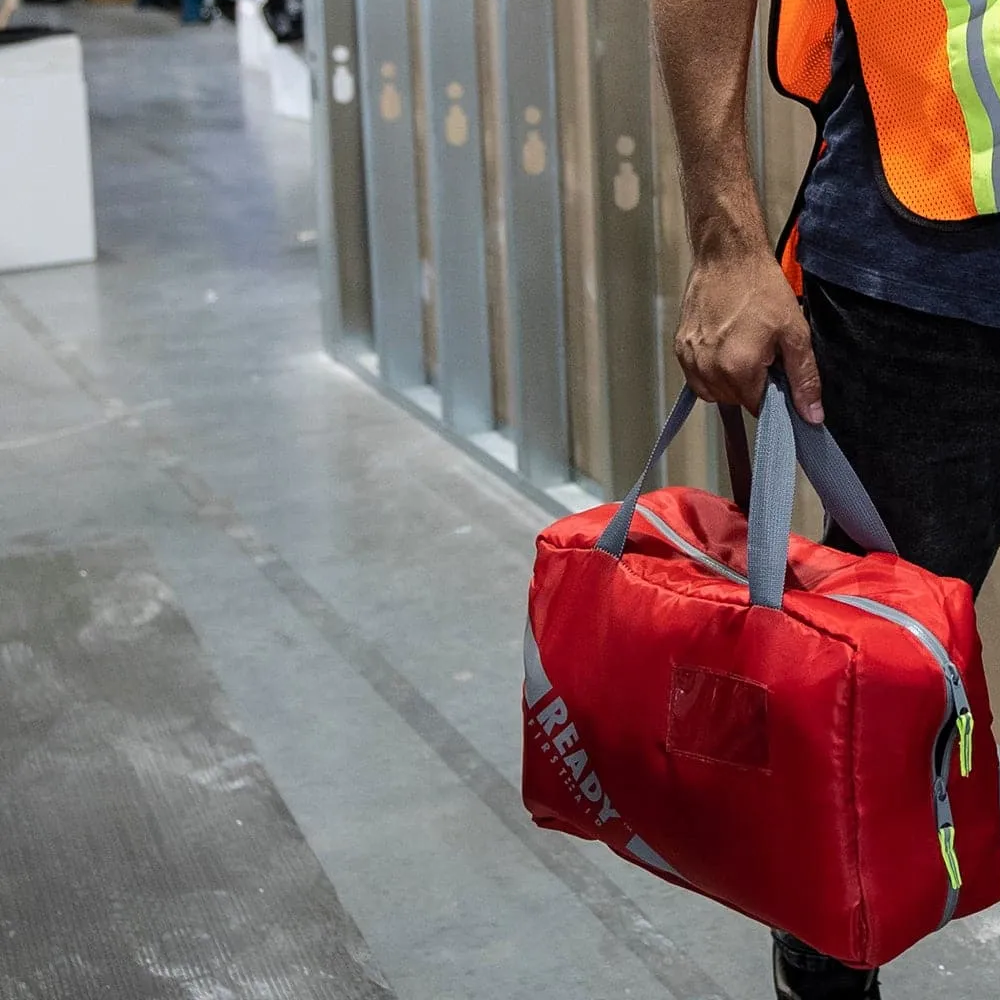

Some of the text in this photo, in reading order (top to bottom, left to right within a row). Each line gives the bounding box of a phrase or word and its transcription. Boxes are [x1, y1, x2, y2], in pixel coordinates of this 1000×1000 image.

[528, 719, 602, 827] FIRST AID
[536, 695, 621, 824] READY
